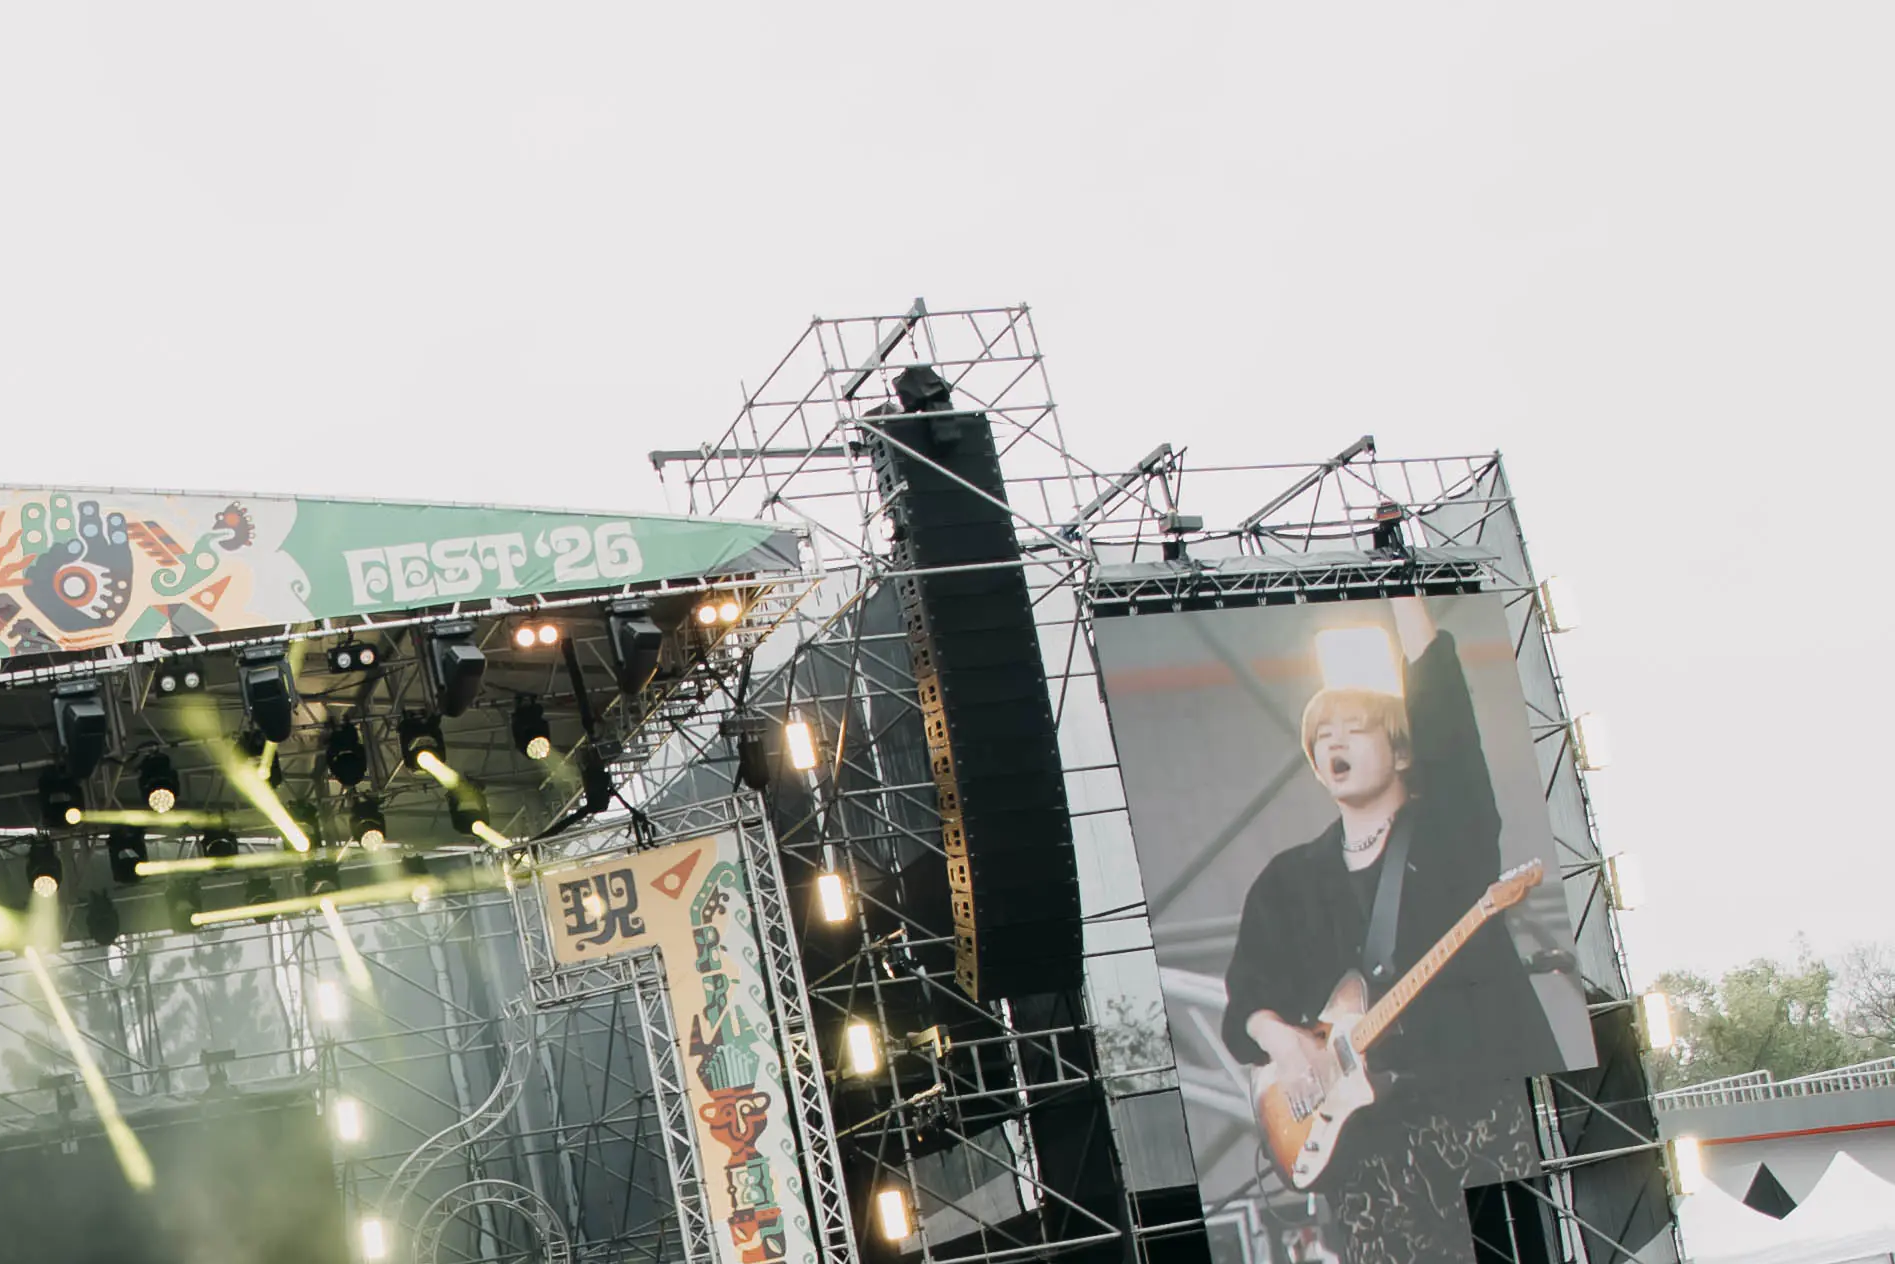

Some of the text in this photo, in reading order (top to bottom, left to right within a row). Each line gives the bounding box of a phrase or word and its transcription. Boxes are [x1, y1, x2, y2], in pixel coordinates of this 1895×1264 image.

[344, 521, 644, 606] FEST '26
[557, 868, 647, 952] 現
